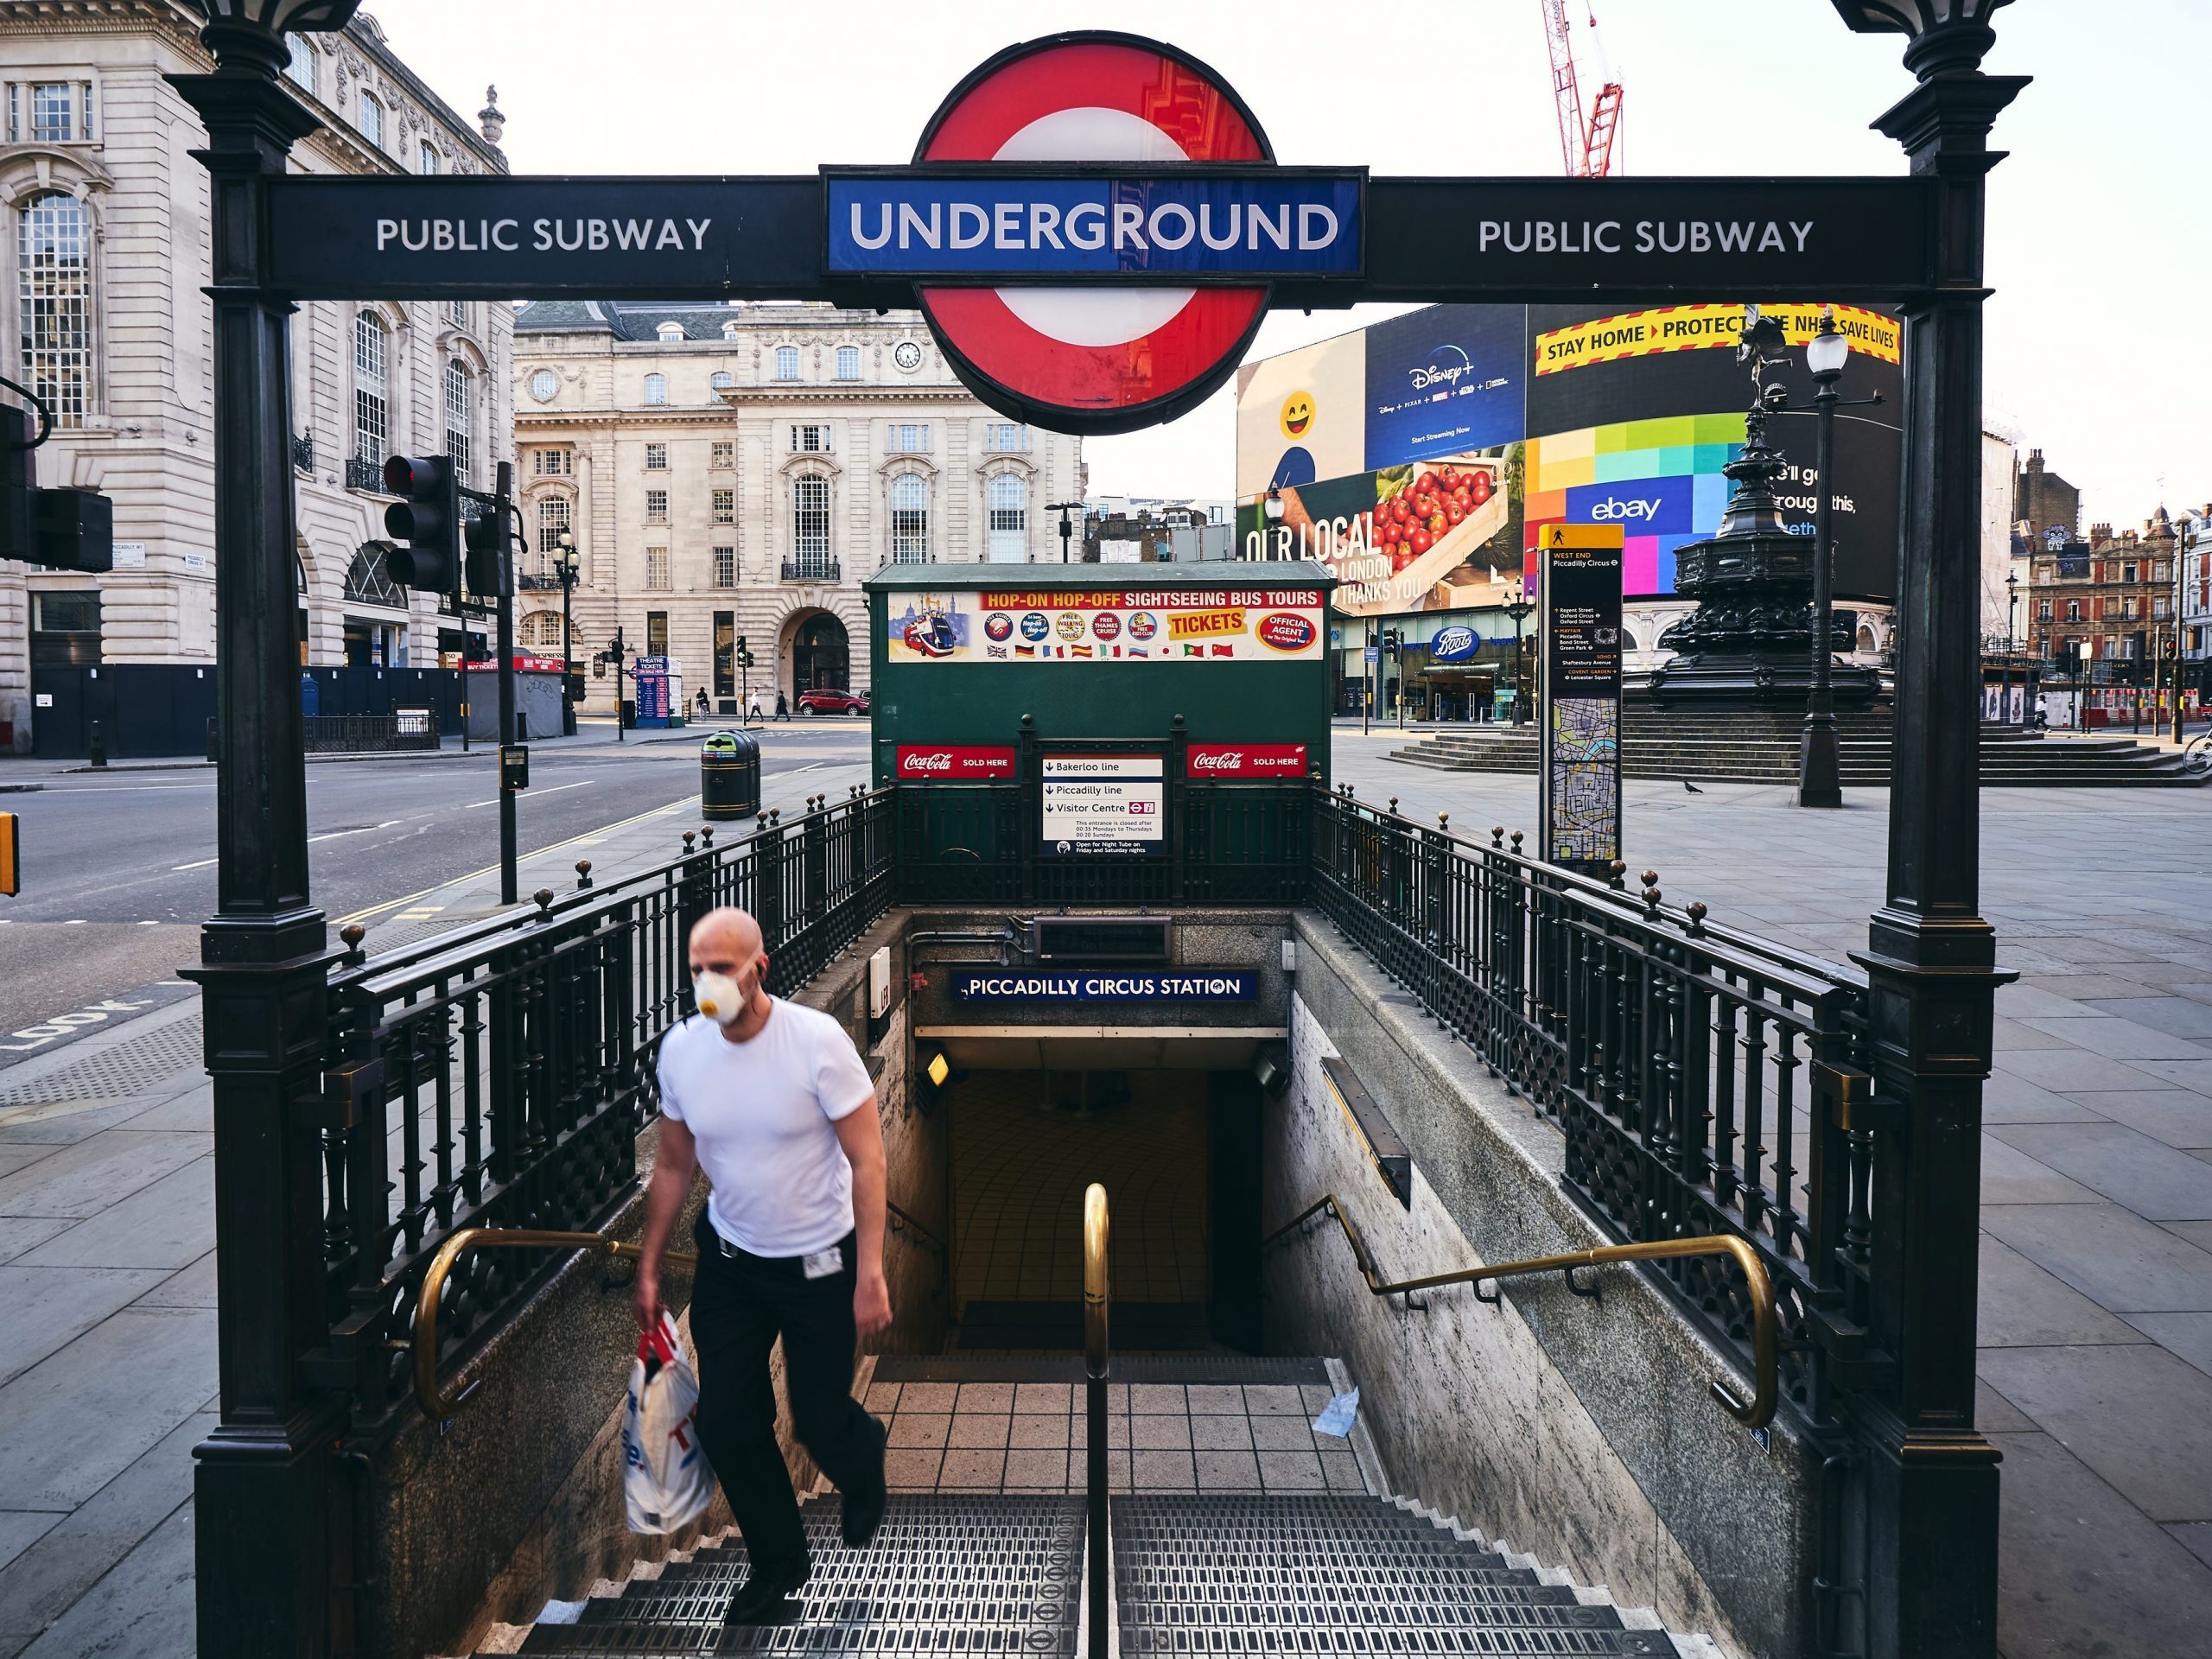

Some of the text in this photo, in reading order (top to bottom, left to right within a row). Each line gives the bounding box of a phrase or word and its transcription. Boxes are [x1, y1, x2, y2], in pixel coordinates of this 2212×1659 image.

[377, 218, 711, 251] PUBLIC SUBWAY
[851, 202, 1338, 250] UNDERGROUND
[1479, 220, 1815, 252] PUBLIC SUBWAY
[1548, 325, 1645, 360] STAY HOME
[1840, 319, 1894, 349] SAVE LIVES
[1404, 398, 1421, 408] PIXAR
[1432, 391, 1448, 402] MARVEL
[1426, 429, 1455, 442] Streaming
[1591, 496, 1662, 521] ebay
[1832, 495, 1856, 514] this,
[1299, 512, 1382, 562] LOCAL
[1341, 556, 1393, 582] LONDON
[988, 591, 1318, 607] HOP-ON HOP-OFF SIGHTSEEING BUS TOURS
[1341, 581, 1390, 605] THANKS
[1393, 577, 1421, 601] YOU
[1171, 612, 1243, 634] TICKETS
[1269, 616, 1309, 628] OFFICIAL
[1272, 626, 1304, 637] AGENT
[1435, 632, 1472, 655] Boots
[904, 753, 953, 770] Coca-Cola
[1056, 762, 1120, 771] Bakerloo line
[1193, 753, 1244, 769] Coca-Cola
[1056, 785, 1122, 796] Piccadilly line
[1056, 804, 1125, 812] Visitor Centre
[969, 979, 1241, 995] PICCADILLY CIRCUS STATION
[0, 1000, 154, 1051] LOOK
